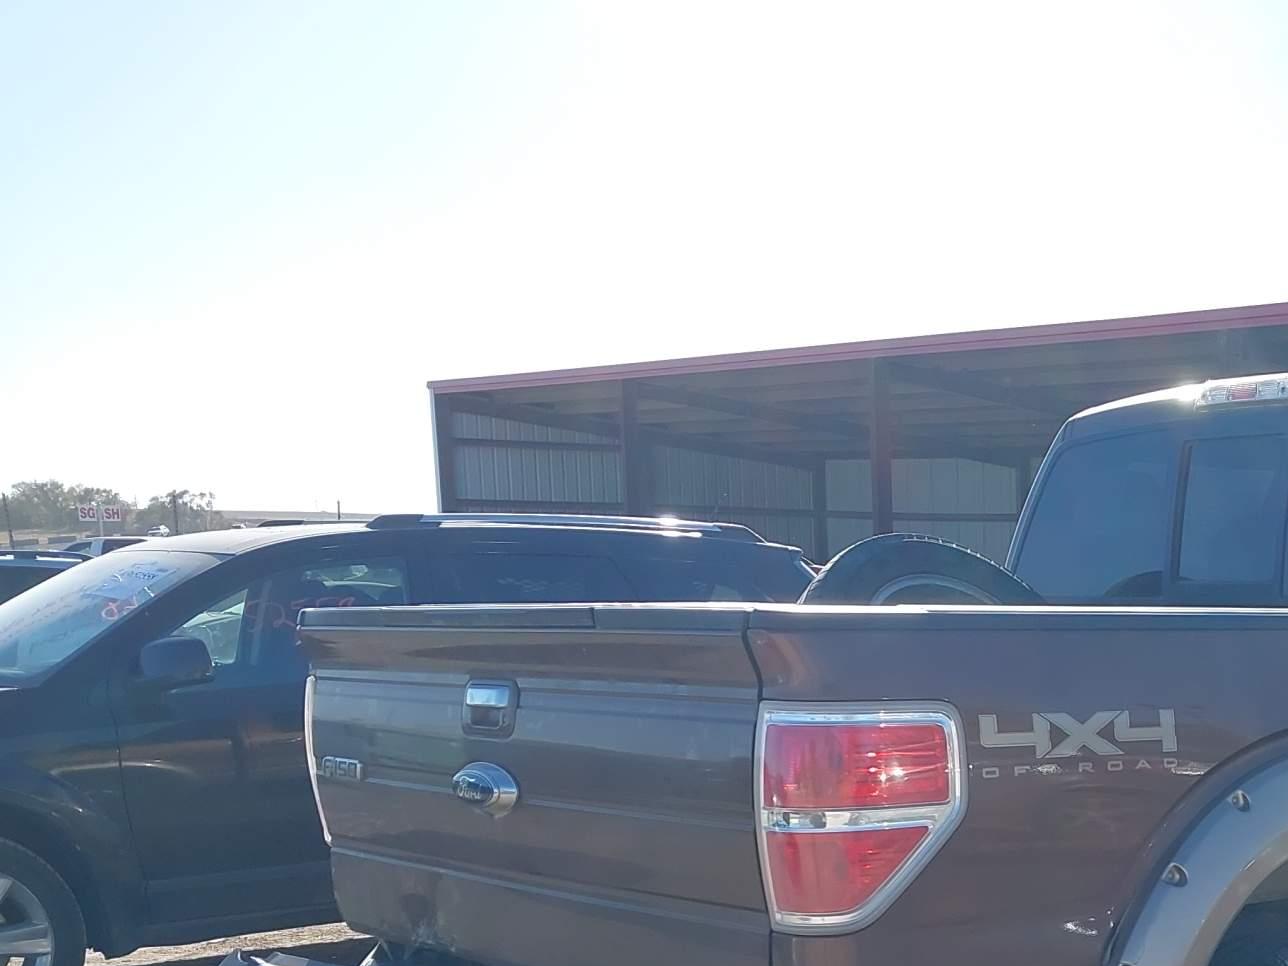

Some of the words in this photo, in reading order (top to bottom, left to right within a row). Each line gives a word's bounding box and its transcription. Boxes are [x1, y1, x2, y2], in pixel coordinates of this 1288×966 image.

[80, 507, 96, 519] SG
[104, 507, 120, 520] SH
[978, 709, 1177, 758] 4X4
